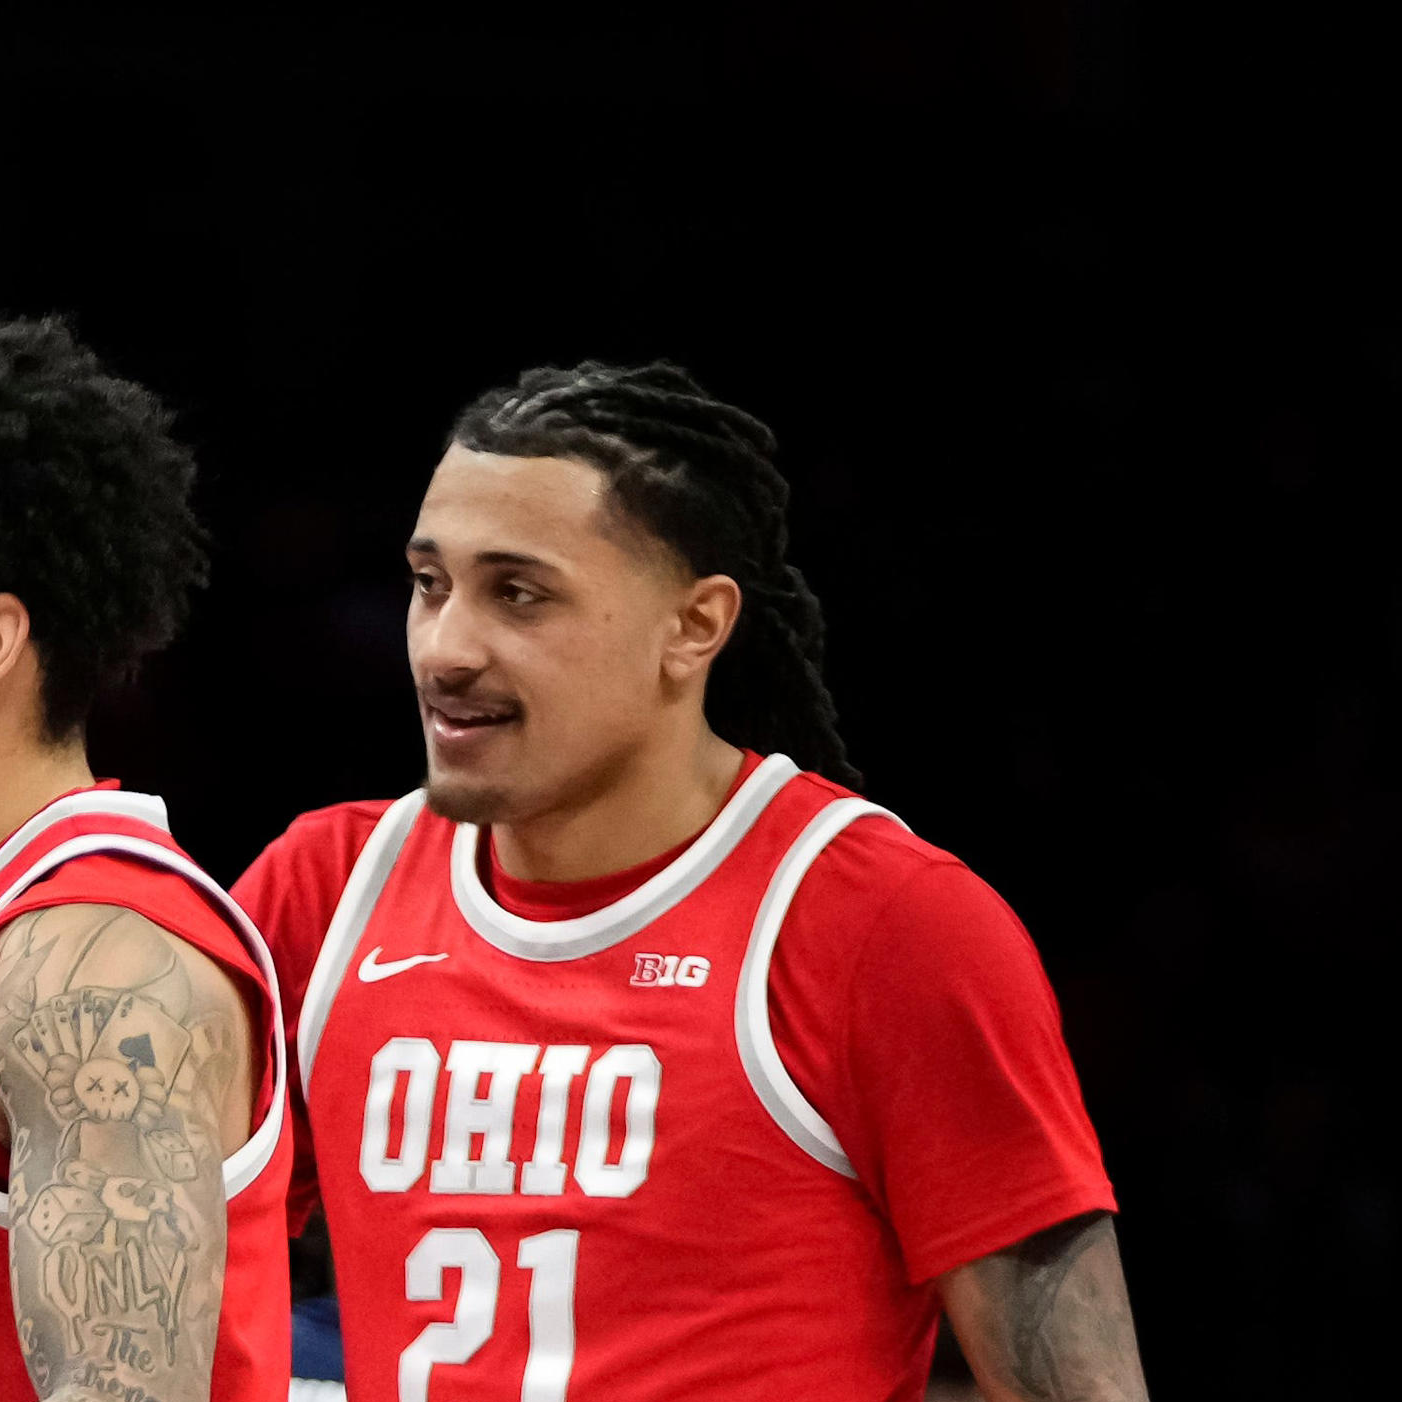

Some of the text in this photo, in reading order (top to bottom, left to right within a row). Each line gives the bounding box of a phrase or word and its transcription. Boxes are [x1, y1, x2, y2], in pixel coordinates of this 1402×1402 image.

[358, 1036, 663, 1198] OHIO
[43, 1237, 188, 1360] ONLY
[92, 1322, 157, 1373] The
